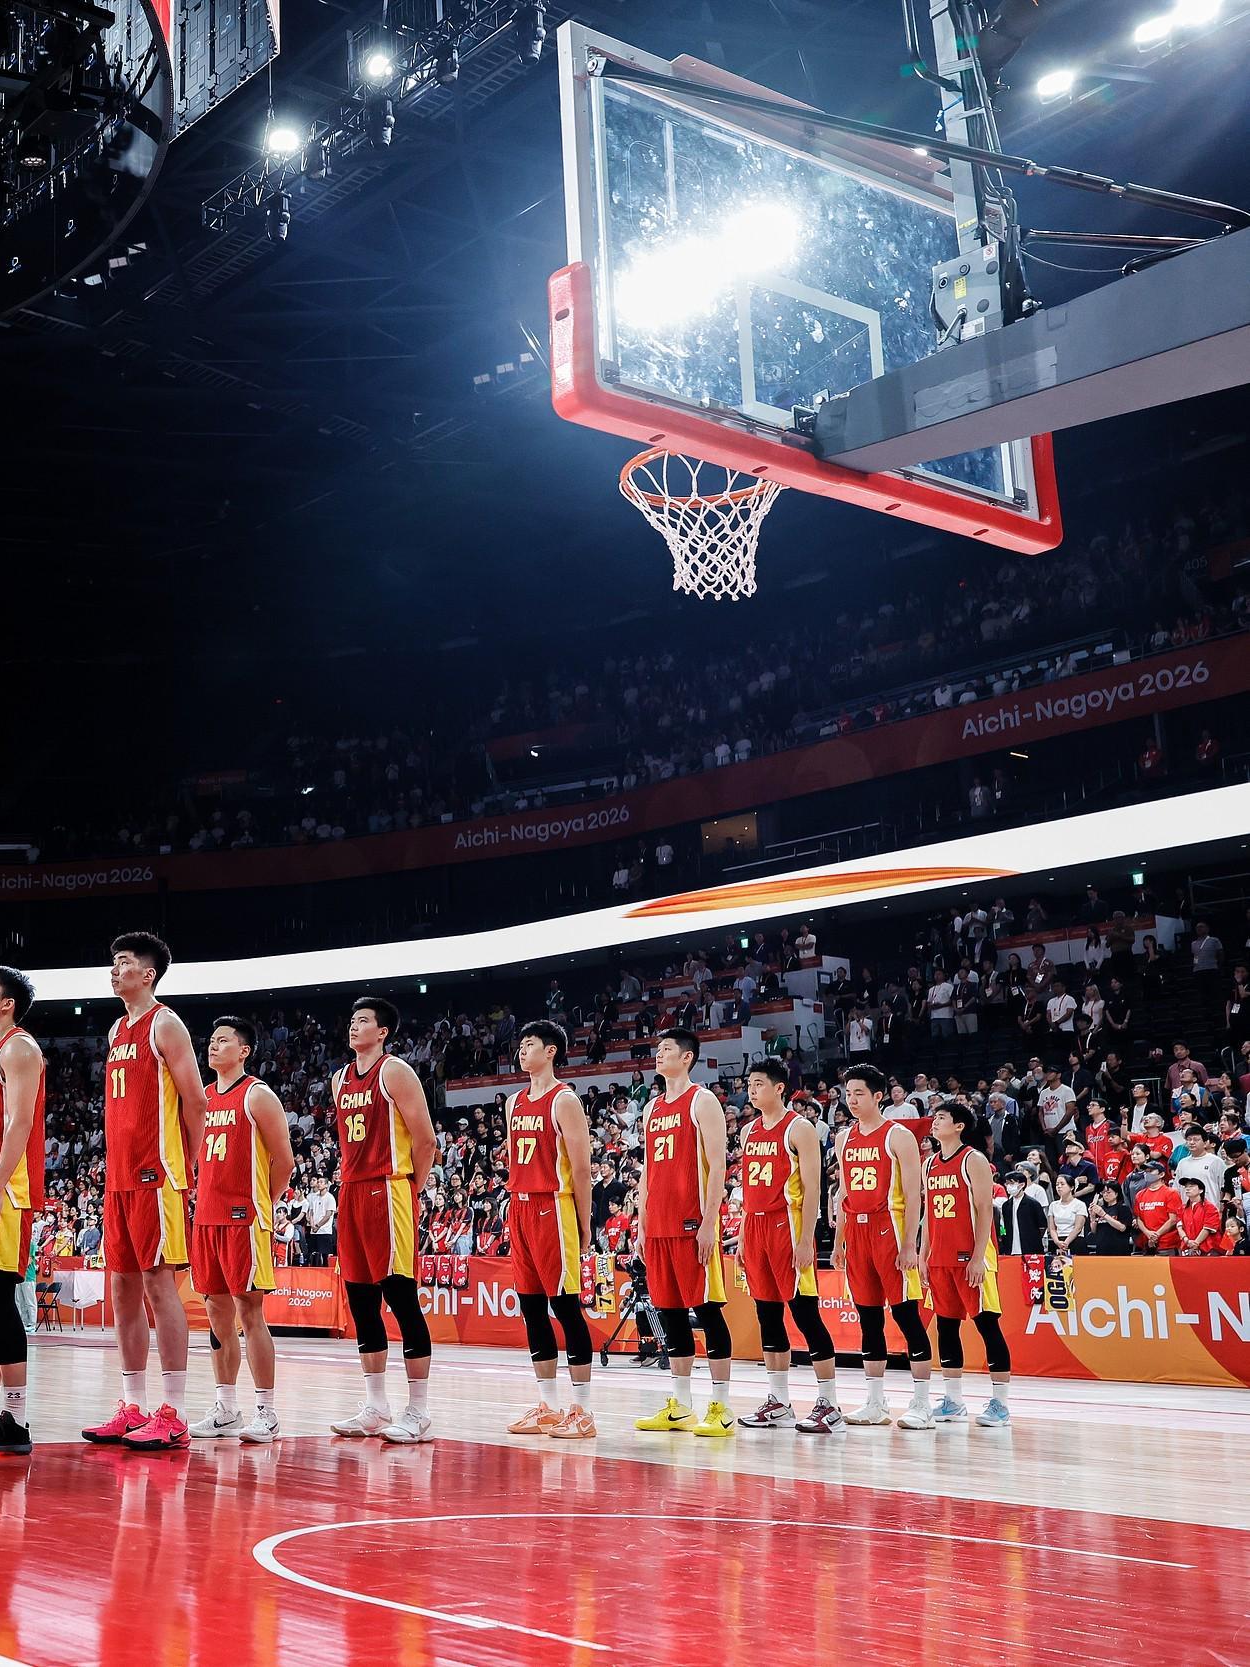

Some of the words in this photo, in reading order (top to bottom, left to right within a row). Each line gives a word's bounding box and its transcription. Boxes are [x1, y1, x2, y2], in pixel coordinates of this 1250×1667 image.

[961, 681, 1134, 739] Aichi-Nagoya
[1137, 660, 1210, 697] 2026
[454, 817, 584, 850] Aichi-Nagoya
[586, 804, 630, 830] 2026
[109, 865, 154, 884] 2026
[110, 1067, 126, 1099] 11
[345, 1113, 366, 1143] 16
[511, 1115, 544, 1132] CHINA
[649, 1112, 681, 1133] CHINA
[205, 1132, 227, 1162] 14
[516, 1137, 537, 1165] 17
[654, 1134, 674, 1162] 21
[745, 1141, 778, 1157] CHINA
[845, 1146, 881, 1162] CHINA
[748, 1161, 773, 1187] 24
[850, 1166, 877, 1191] 26
[927, 1174, 959, 1190] CHINA
[932, 1193, 956, 1219] 32
[289, 1297, 312, 1307] 2026
